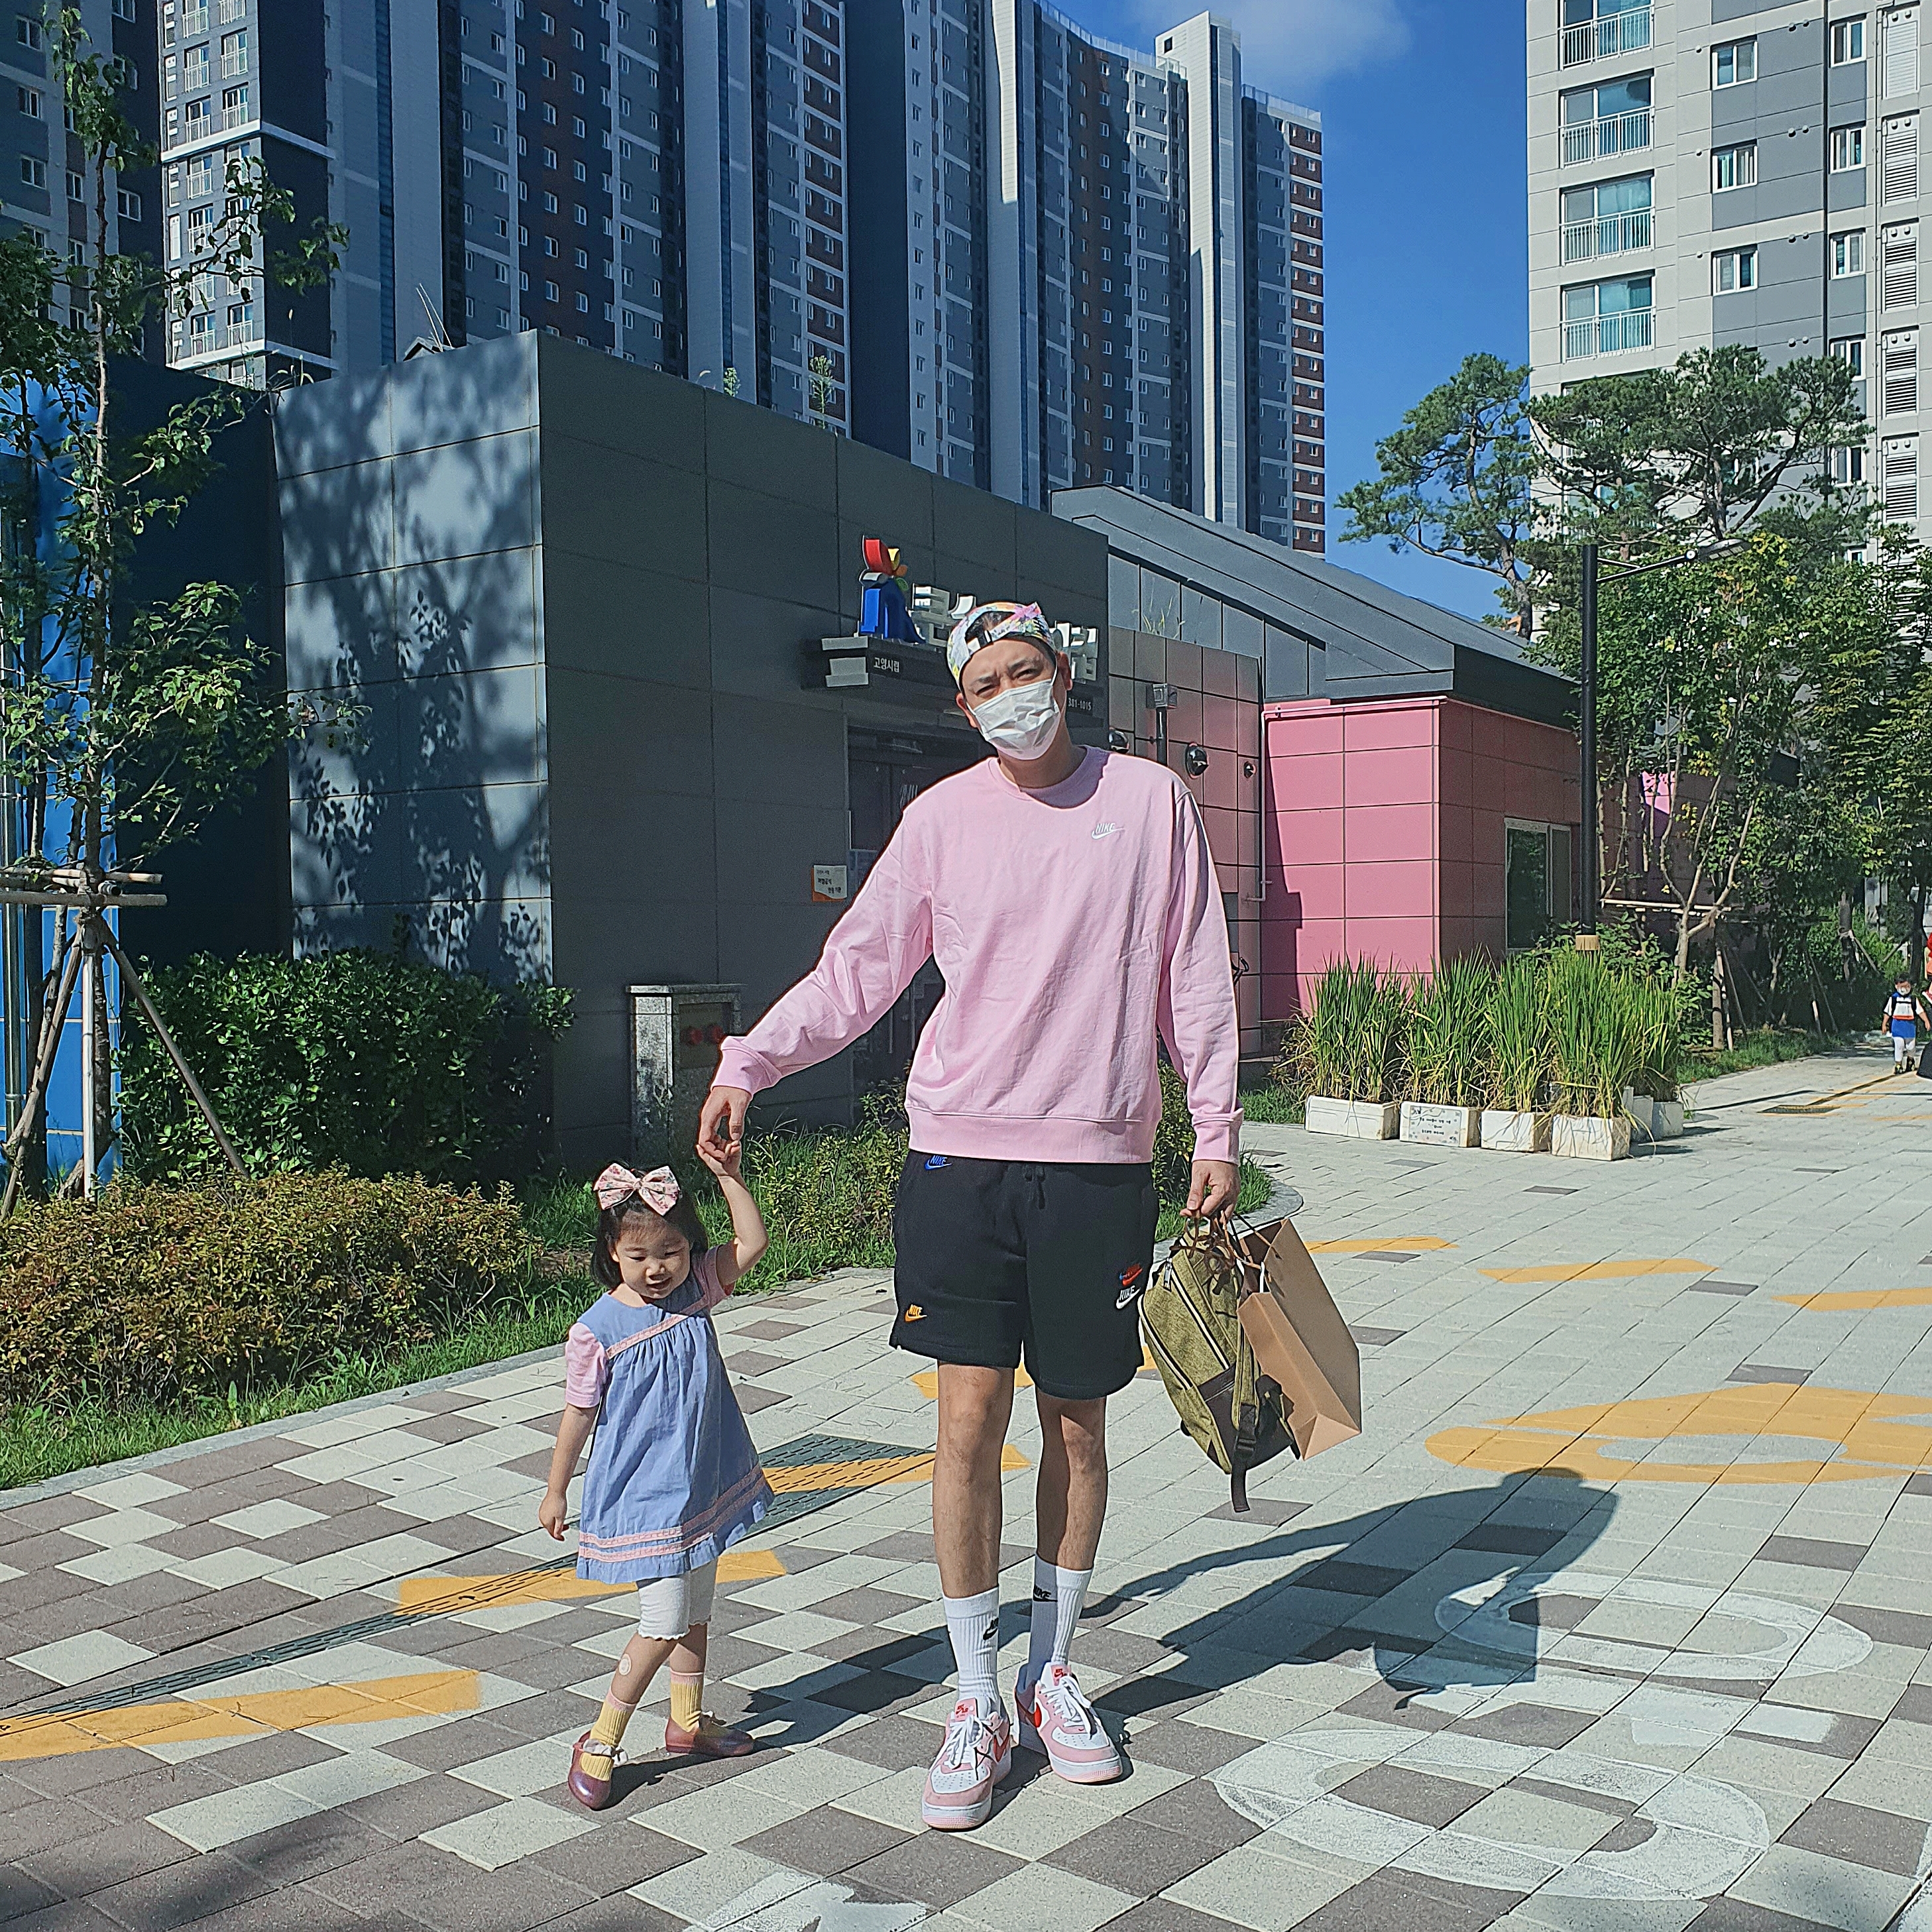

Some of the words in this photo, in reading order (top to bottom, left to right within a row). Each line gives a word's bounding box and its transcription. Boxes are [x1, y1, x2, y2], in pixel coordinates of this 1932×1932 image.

[873, 657, 900, 673] 고양시립
[1068, 697, 1092, 711] 381-1015
[1095, 823, 1116, 834] NIKE
[930, 1155, 948, 1165] NIKE
[1119, 1285, 1135, 1300] NIKE
[909, 1304, 923, 1316] NIKE
